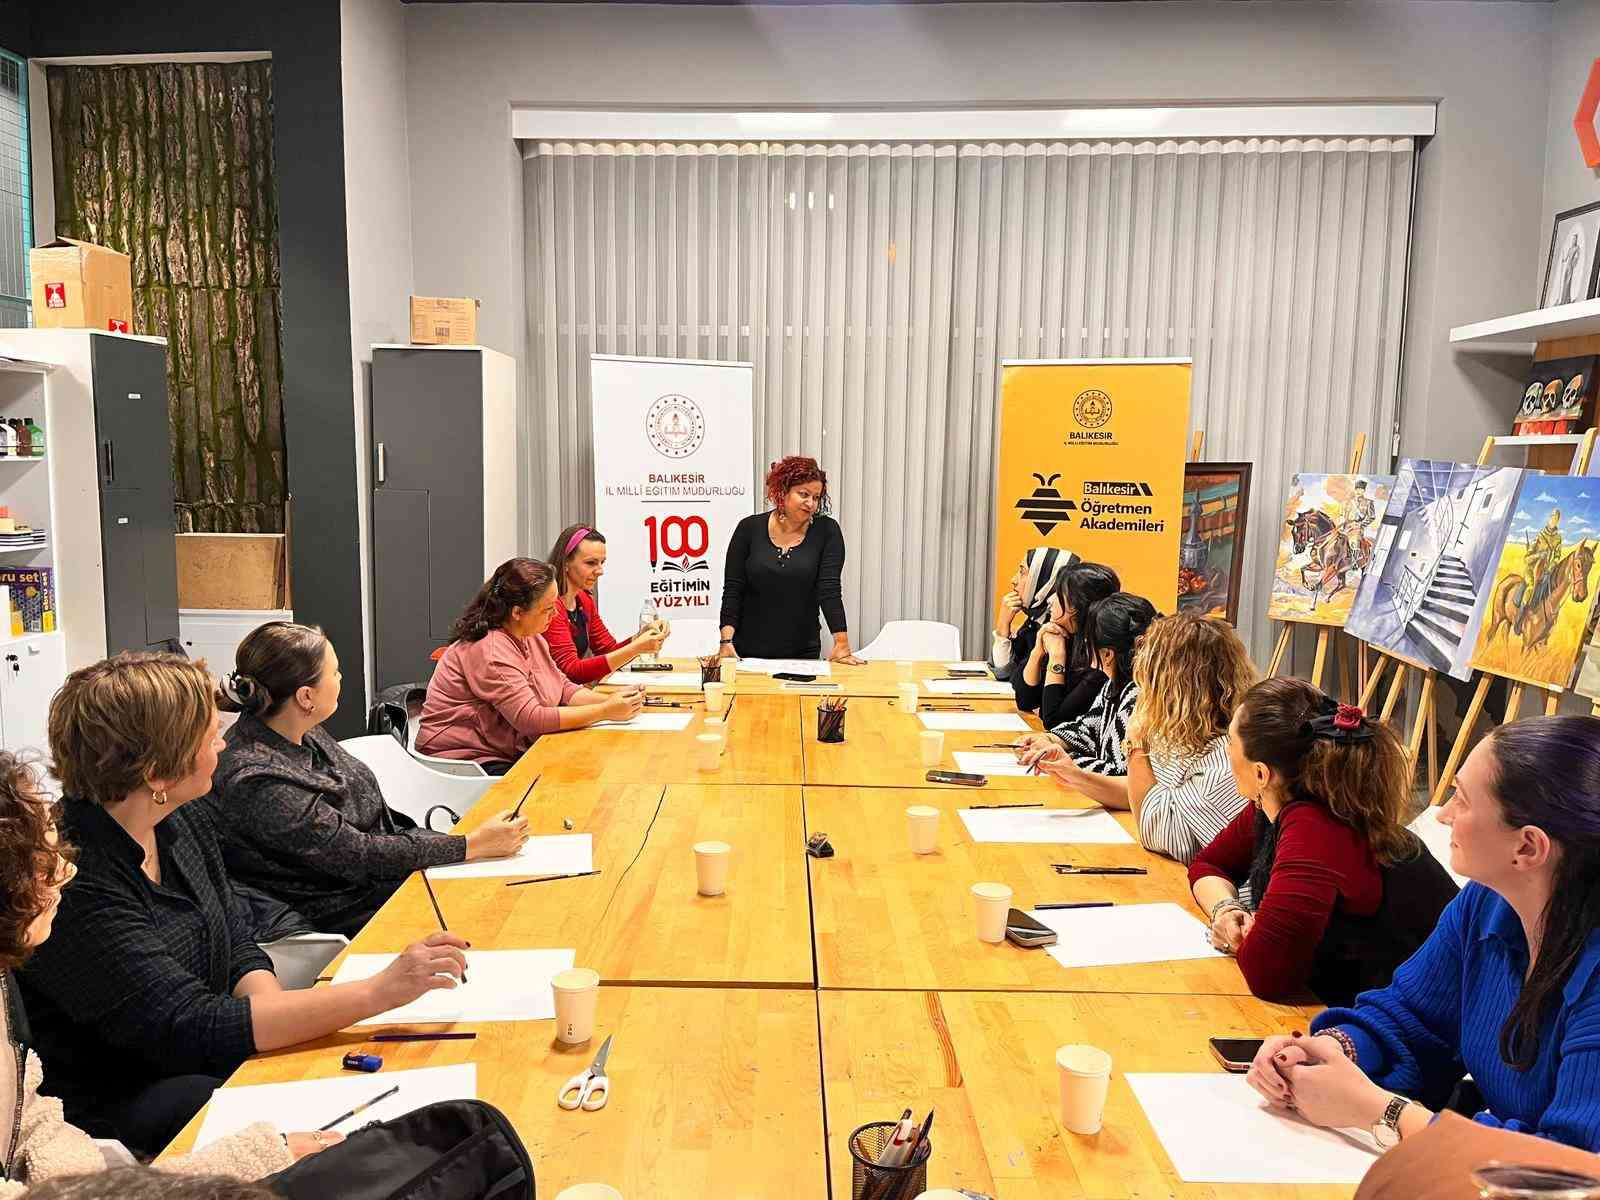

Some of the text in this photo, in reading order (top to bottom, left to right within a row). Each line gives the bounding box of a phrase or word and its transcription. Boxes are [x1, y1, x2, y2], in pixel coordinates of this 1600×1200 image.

[1084, 482, 1136, 495] Balıkesir
[1081, 498, 1152, 516] Öğretmen
[1080, 517, 1164, 532] Akademileri
[644, 515, 709, 573] 100
[0, 572, 39, 583] ru set
[650, 578, 710, 593] EĞİTİMİN
[653, 594, 709, 608] YÜZYILI
